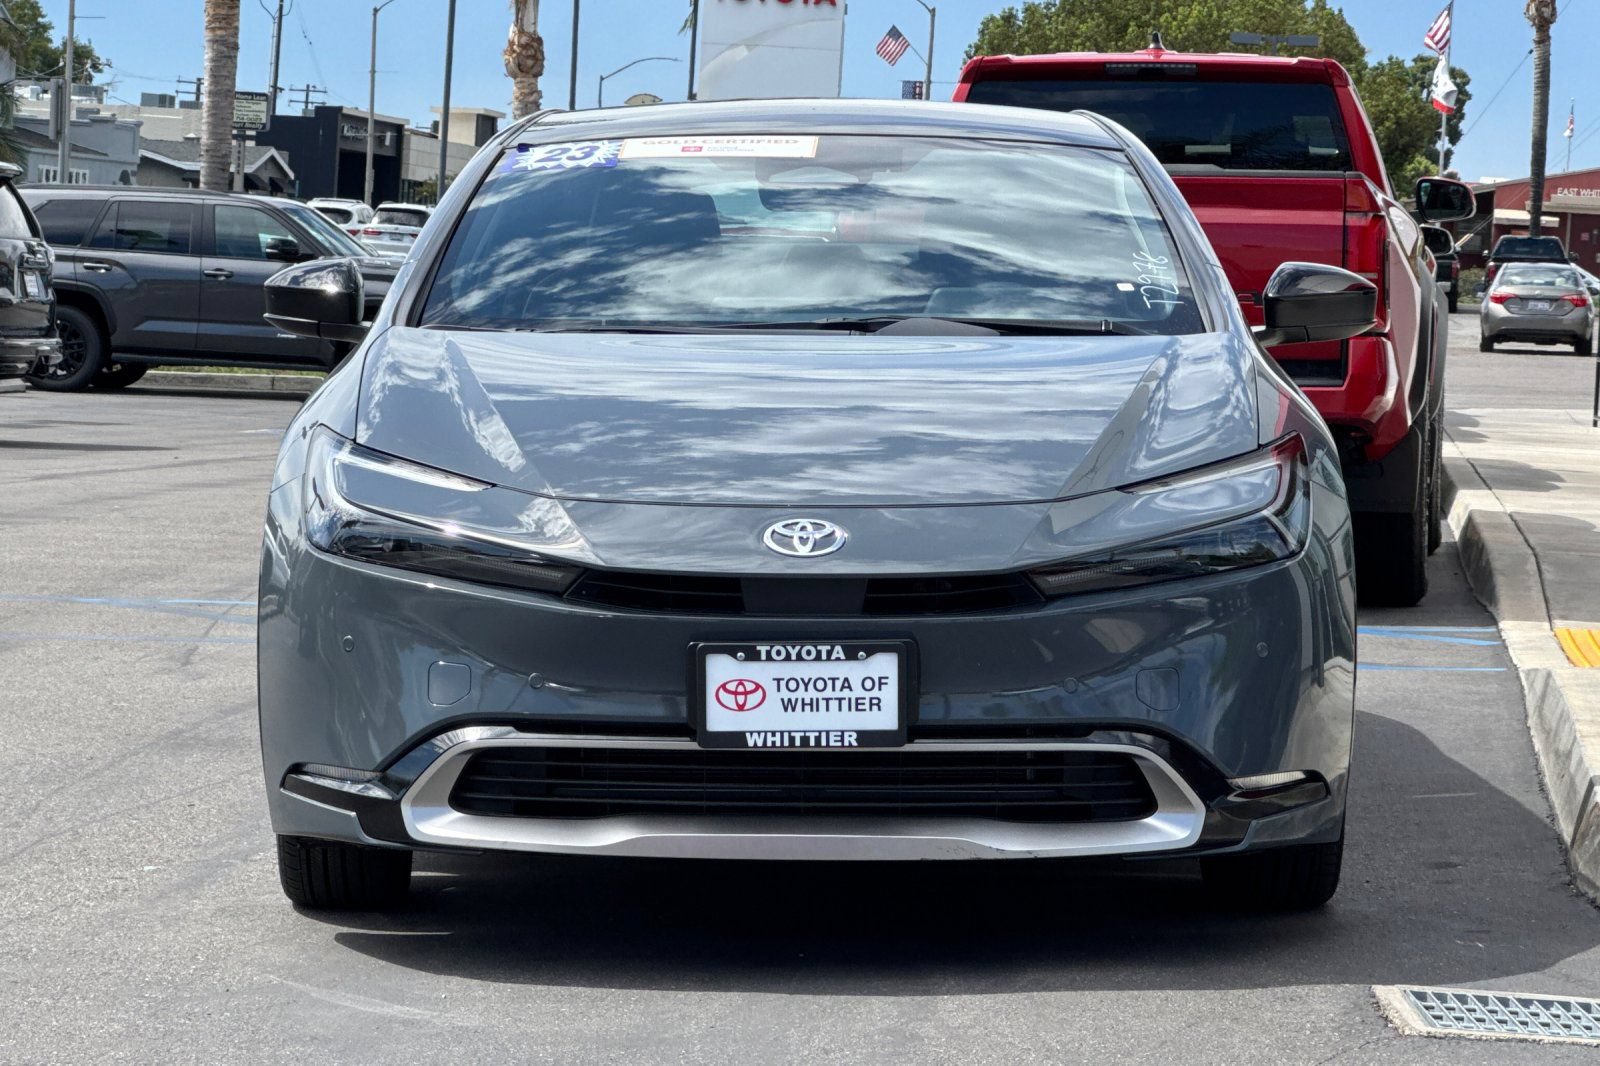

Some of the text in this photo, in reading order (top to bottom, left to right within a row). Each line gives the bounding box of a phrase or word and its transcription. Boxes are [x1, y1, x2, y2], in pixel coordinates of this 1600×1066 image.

[534, 145, 601, 163] 23
[1557, 187, 1578, 197] EAST
[756, 645, 846, 661] TOYOTA
[772, 676, 889, 693] TOYOTA OF
[780, 697, 882, 712] WHITTIER
[746, 732, 858, 747] WHITTIER
